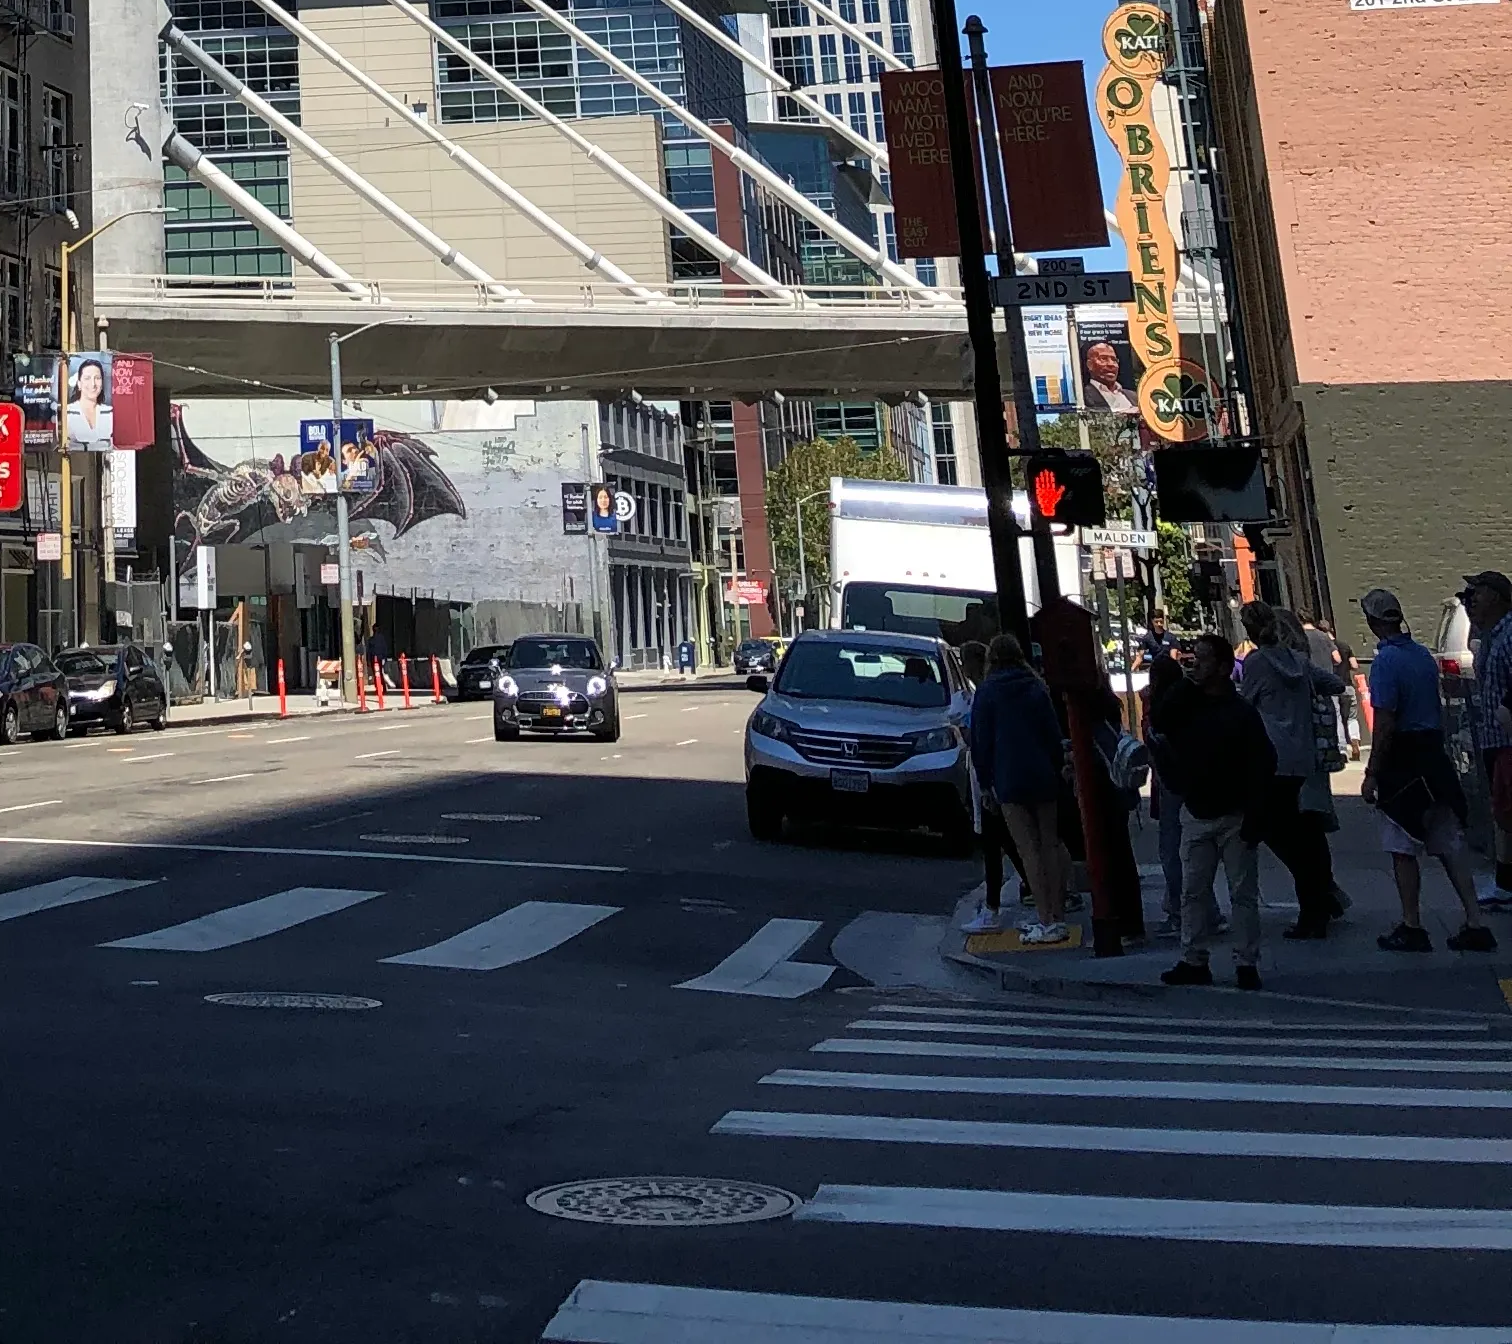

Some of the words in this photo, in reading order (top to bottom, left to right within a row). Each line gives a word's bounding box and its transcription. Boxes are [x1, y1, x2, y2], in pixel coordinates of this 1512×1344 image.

[1008, 74, 1044, 90] AND
[889, 97, 939, 114] MAM-
[998, 91, 1044, 108] NOW
[1013, 106, 1073, 125] YOU'RE
[892, 131, 935, 149] LIVED
[1004, 125, 1051, 143] HERE.
[902, 217, 923, 226] THE
[903, 226, 929, 237] EAST
[904, 237, 926, 248] CUT
[1042, 261, 1067, 271] 200
[1017, 280, 1068, 299] 2ND
[1083, 279, 1110, 297] ST
[1158, 397, 1202, 412] KATE
[1092, 531, 1147, 544] MALDEN
